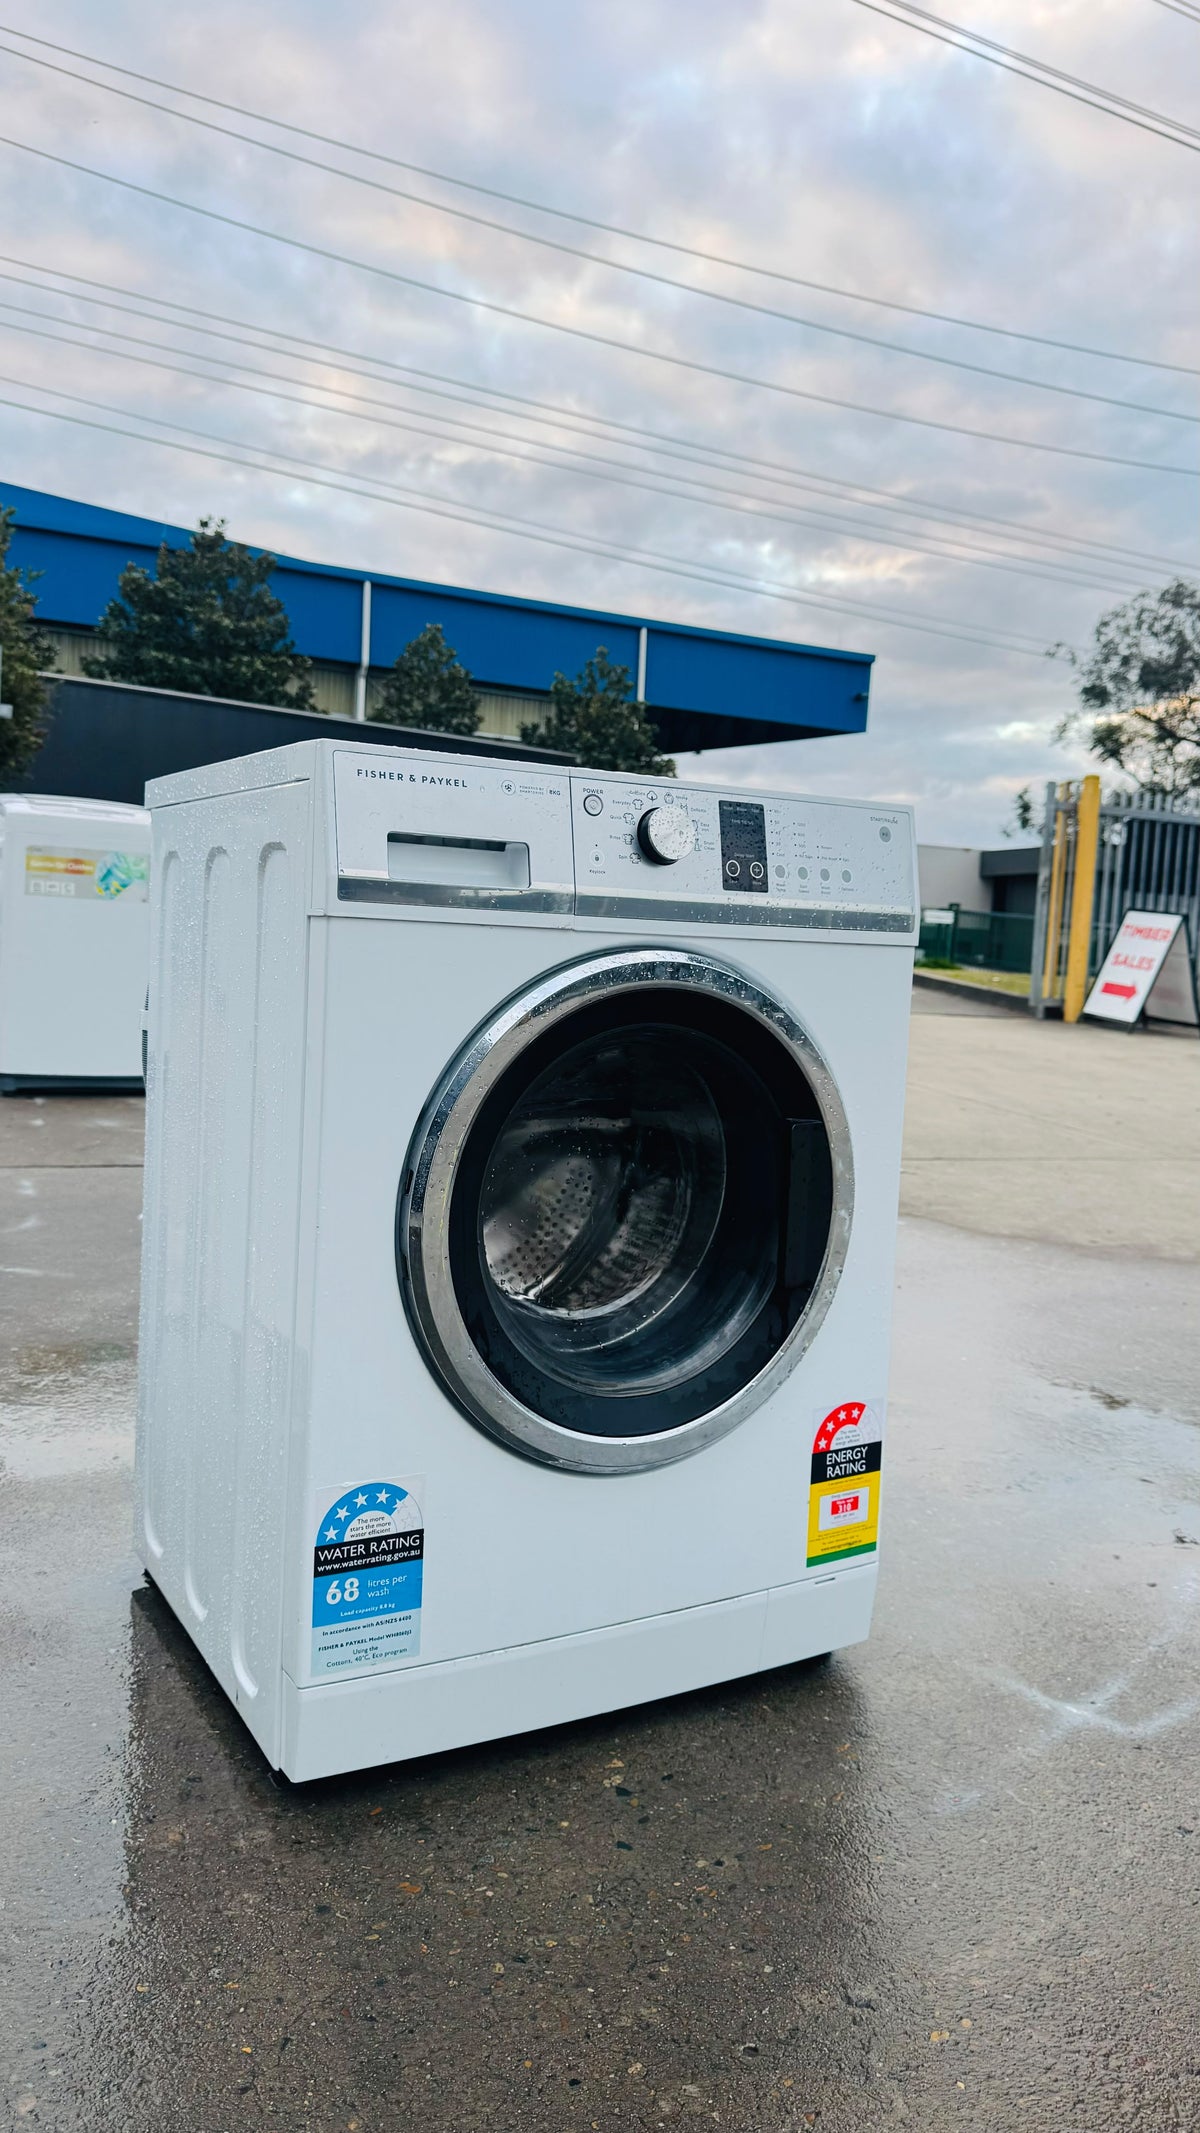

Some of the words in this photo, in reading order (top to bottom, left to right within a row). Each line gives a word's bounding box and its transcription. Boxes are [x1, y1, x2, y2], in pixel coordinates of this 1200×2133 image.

[357, 768, 404, 782] FISHER
[409, 774, 417, 782] &
[421, 775, 468, 788] PAYKEL
[582, 787, 604, 795] POWER
[1122, 924, 1172, 941] TIMBER
[1111, 953, 1155, 971] SALES
[826, 1446, 868, 1465] ENERGY
[826, 1460, 866, 1479] RATING
[838, 1502, 852, 1514] 310
[350, 1531, 367, 1539] water
[368, 1527, 391, 1537] efficient
[318, 1543, 366, 1562] WATER
[370, 1534, 420, 1554] RATING
[317, 1548, 421, 1572] www.waterrating.gov.au
[367, 1578, 390, 1588] litres
[392, 1574, 407, 1586] per
[326, 1577, 360, 1605] 68
[367, 1587, 390, 1598] wash
[340, 1609, 354, 1617] Load
[355, 1605, 378, 1615] capacity
[329, 1624, 361, 1635] accordance
[318, 1643, 339, 1653] FISHER
[345, 1638, 367, 1647] PAYKEL
[369, 1634, 385, 1642] Model
[352, 1648, 369, 1656] Using
[372, 1651, 383, 1659] Eco
[384, 1647, 408, 1658] program
